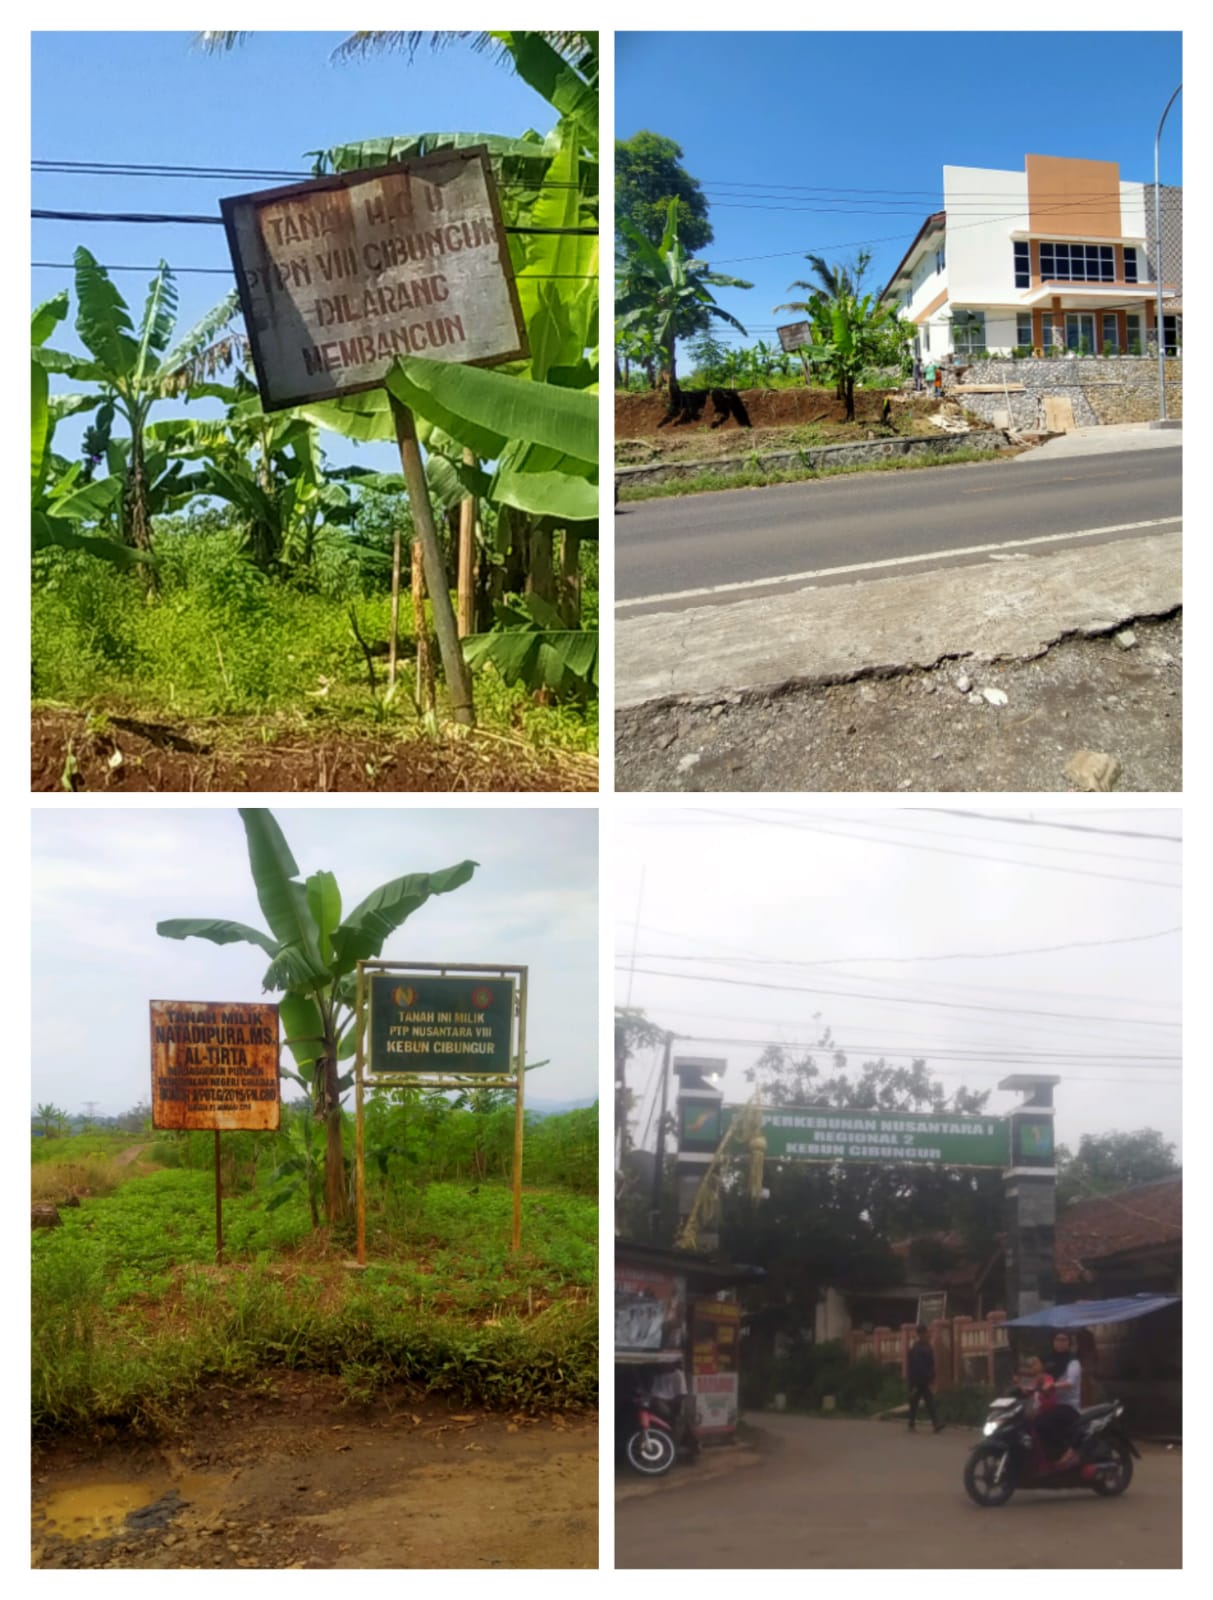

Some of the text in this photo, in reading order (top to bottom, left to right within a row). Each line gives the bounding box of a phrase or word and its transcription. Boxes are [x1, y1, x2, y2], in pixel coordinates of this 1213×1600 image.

[268, 204, 348, 247] TANA
[316, 247, 358, 283] VIII
[166, 1010, 263, 1025] TANAH MILIK
[399, 1011, 485, 1024] TANAH INI MILIK
[389, 1025, 492, 1038] PTP NUSANTARA VIII
[386, 1040, 496, 1054] KEBUN CIBUNGUR
[185, 1046, 248, 1065] AL-TIRTA
[762, 1115, 877, 1131] PERKEBUNAN
[881, 1120, 985, 1135] NUSANTARA
[813, 1130, 915, 1145] REGIONAL 2
[785, 1142, 942, 1159] KEBUN CIBUNGUR
